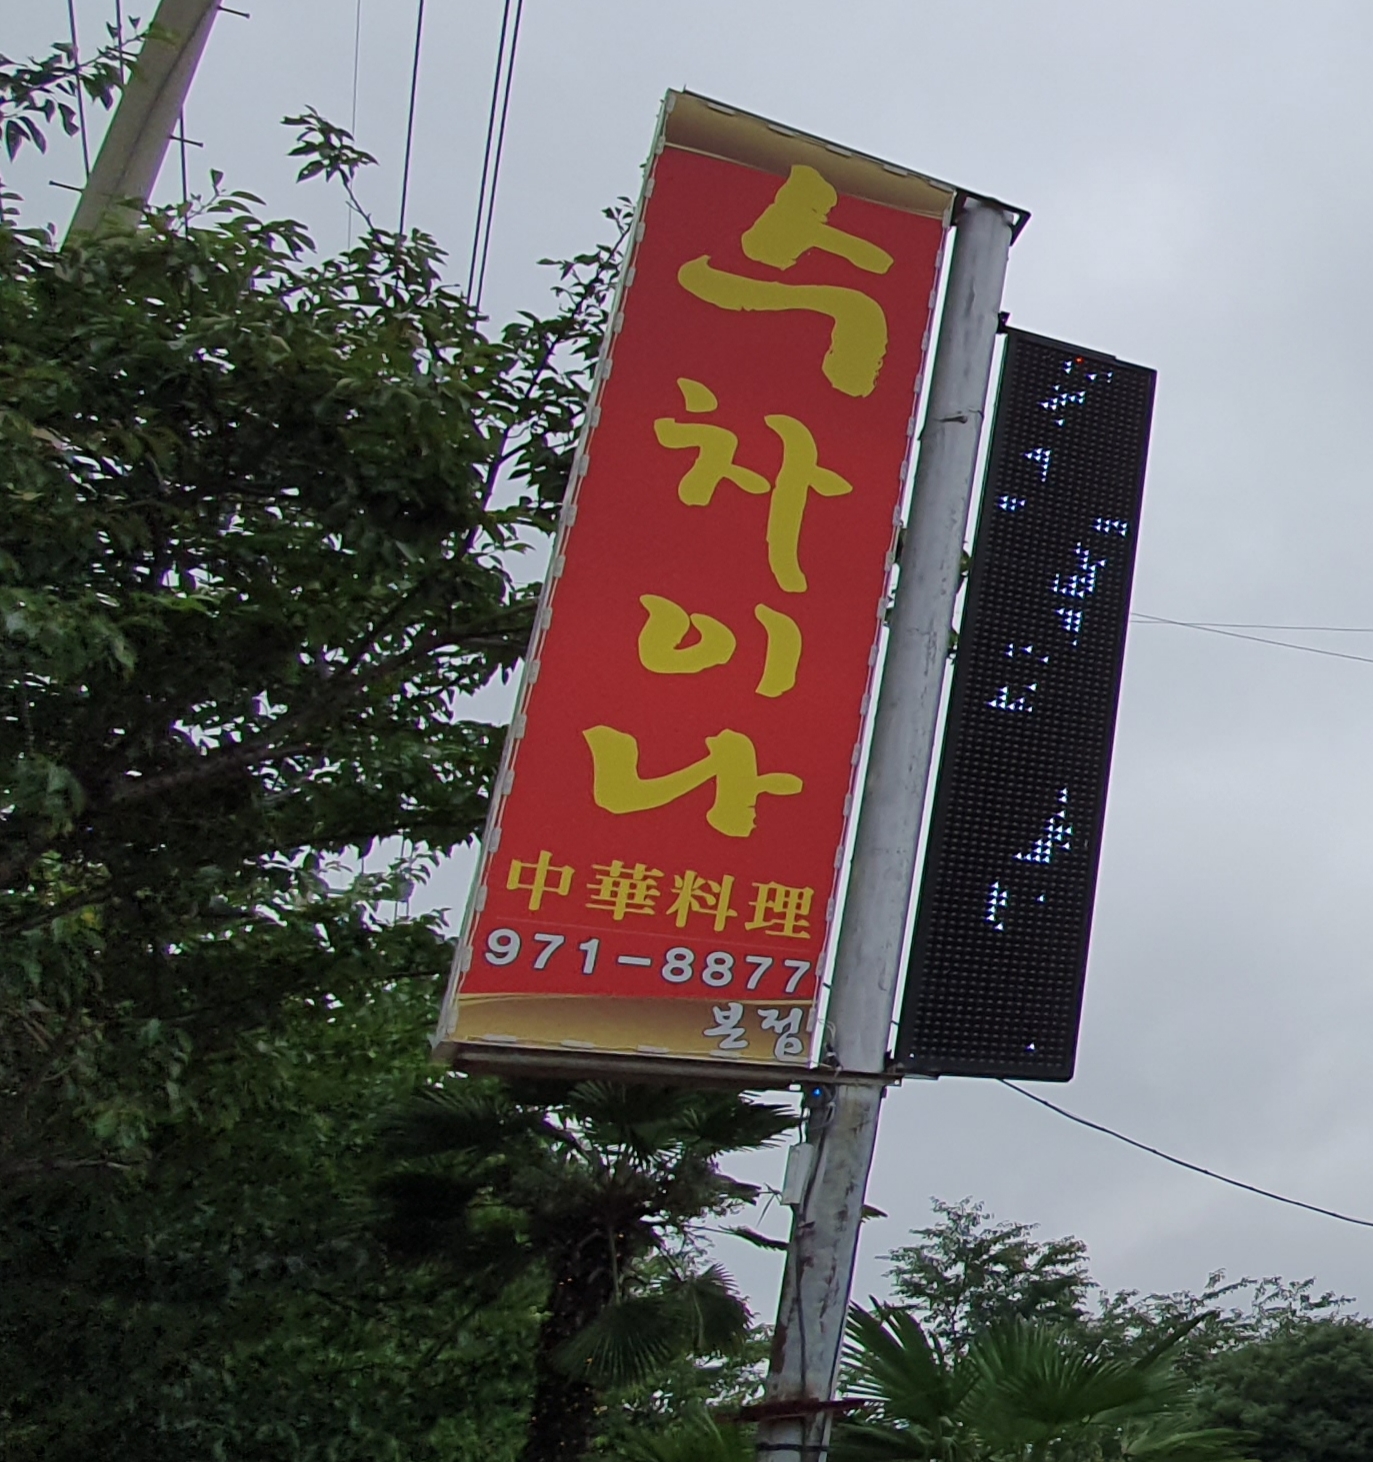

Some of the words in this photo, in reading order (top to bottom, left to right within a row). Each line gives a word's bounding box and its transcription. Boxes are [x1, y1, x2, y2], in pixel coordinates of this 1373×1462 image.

[506, 850, 815, 939] 中華料理
[484, 928, 811, 993] 971-8877
[703, 1002, 804, 1061] 본점
